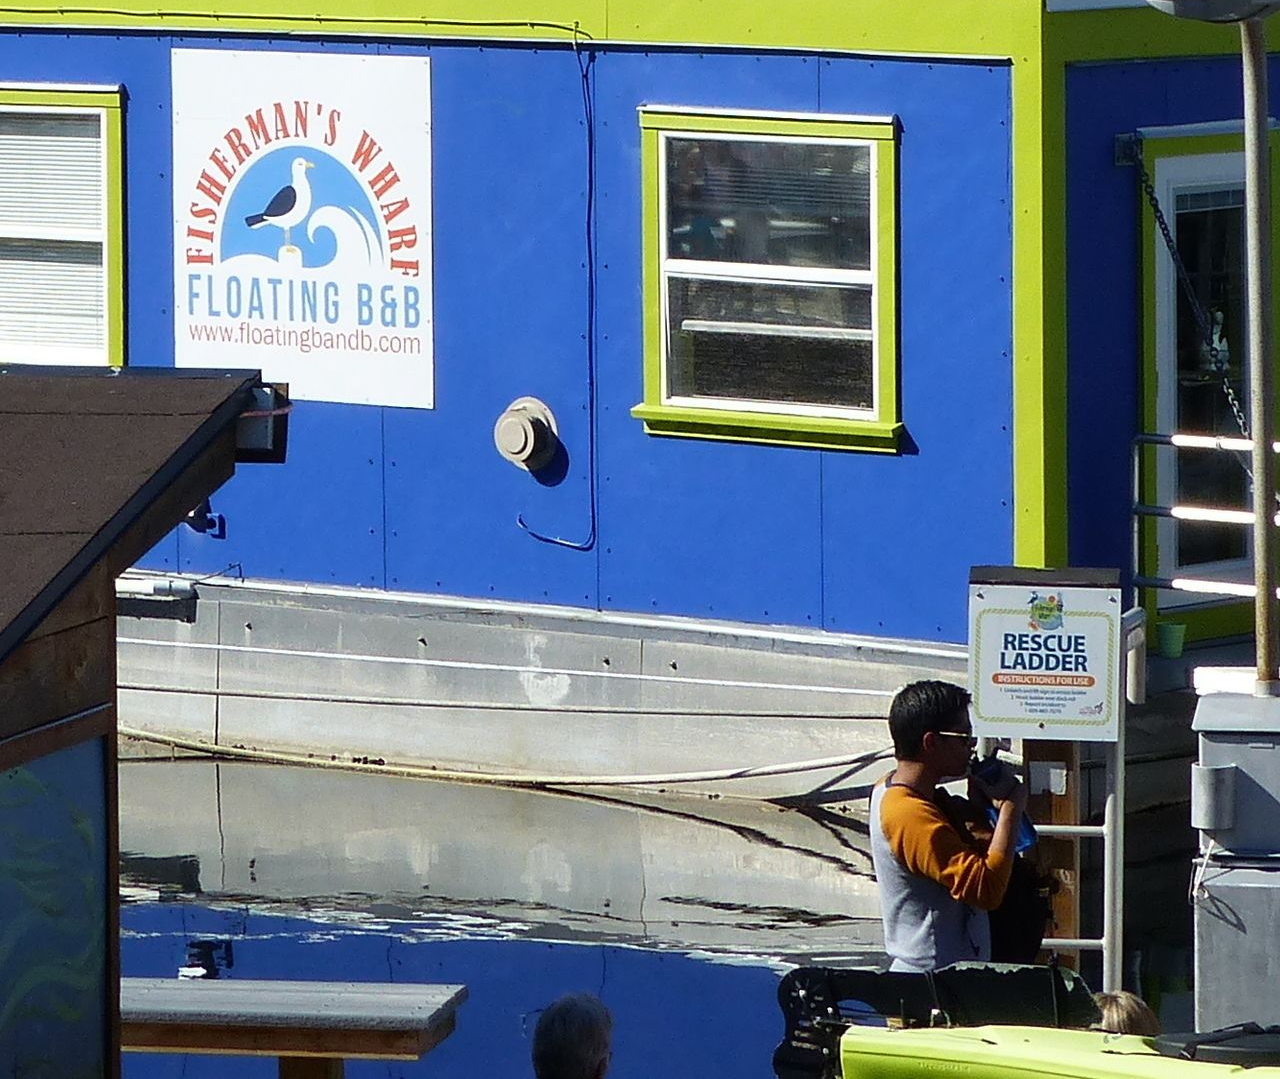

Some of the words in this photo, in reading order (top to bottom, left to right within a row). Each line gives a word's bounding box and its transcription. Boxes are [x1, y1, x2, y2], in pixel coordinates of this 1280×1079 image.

[186, 100, 341, 266] FISHERMAN'S
[351, 129, 420, 277] WHARF
[188, 274, 340, 325] FLOATING
[357, 283, 420, 329] B&B
[189, 322, 421, 354] www.floatingbandb.com
[1003, 633, 1085, 653] RESCUE
[1000, 652, 1087, 672] LADDER
[998, 675, 1055, 685] INSTRUCTIONS
[1057, 676, 1072, 685] FOR
[1073, 677, 1089, 686] USE
